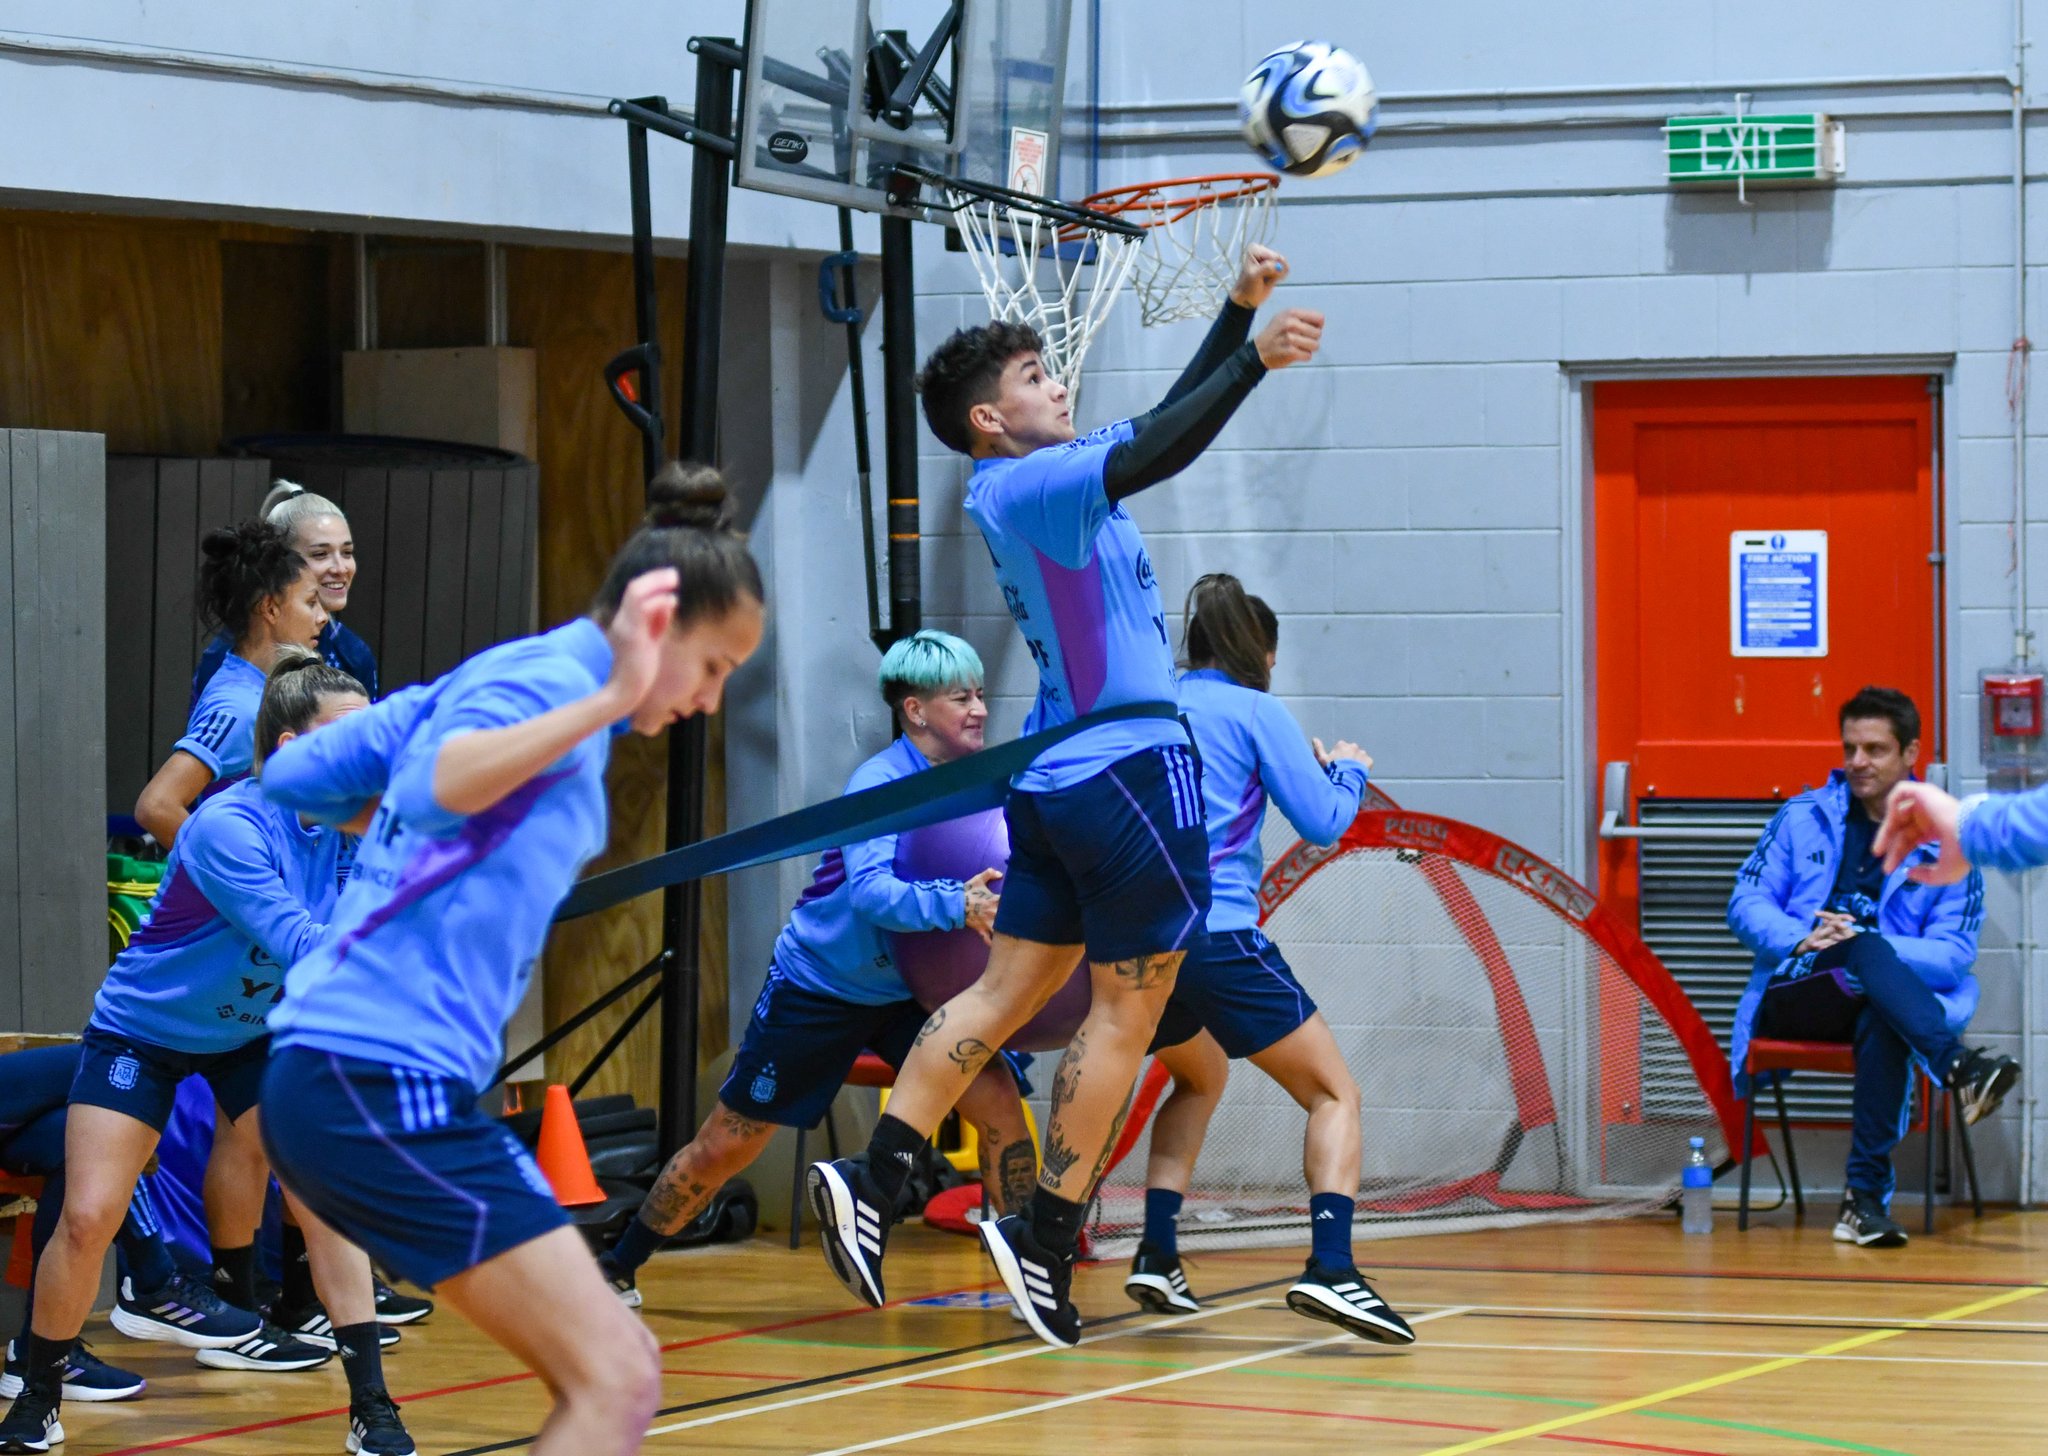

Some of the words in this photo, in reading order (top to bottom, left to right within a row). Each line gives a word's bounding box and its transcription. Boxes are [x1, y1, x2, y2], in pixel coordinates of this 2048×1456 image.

[774, 137, 804, 150] GENKI
[1701, 126, 1784, 171] EXIT
[1745, 553, 1771, 564] FIRE
[1771, 553, 1812, 564] ACTION
